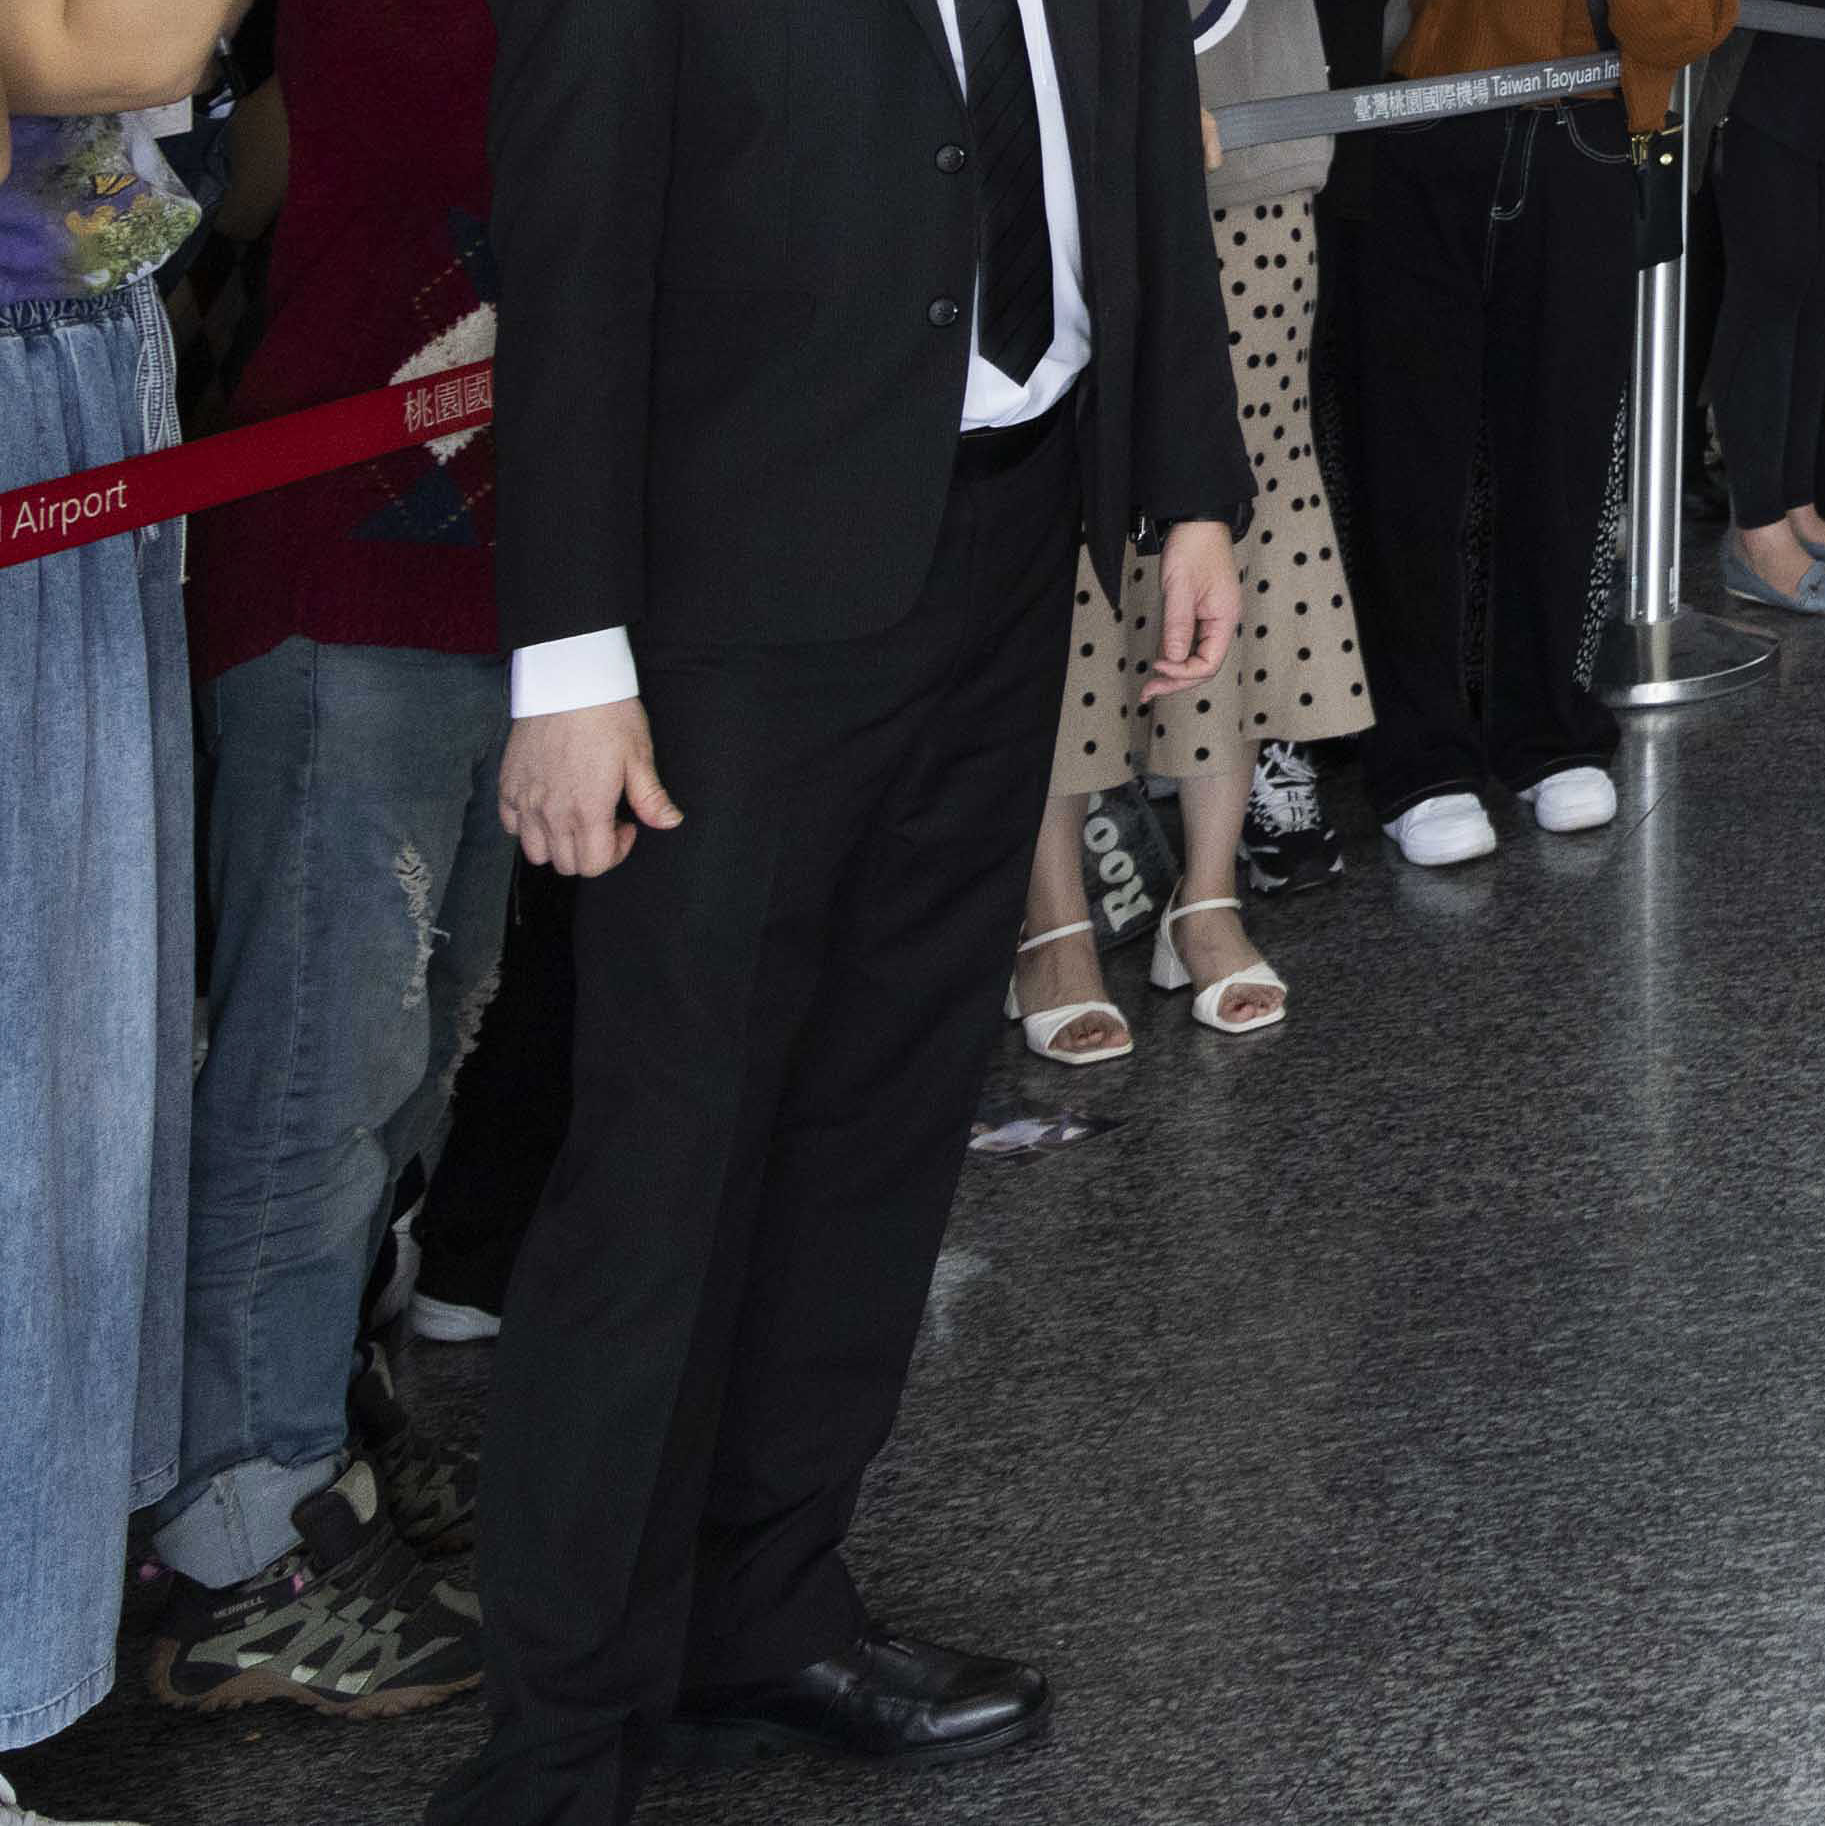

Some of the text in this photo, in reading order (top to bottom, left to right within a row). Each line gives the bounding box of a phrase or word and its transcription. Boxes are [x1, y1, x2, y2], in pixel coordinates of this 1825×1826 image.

[1490, 74, 1542, 98] Taiwan
[1543, 65, 1601, 94] Taoyuan
[11, 479, 128, 540] Airport
